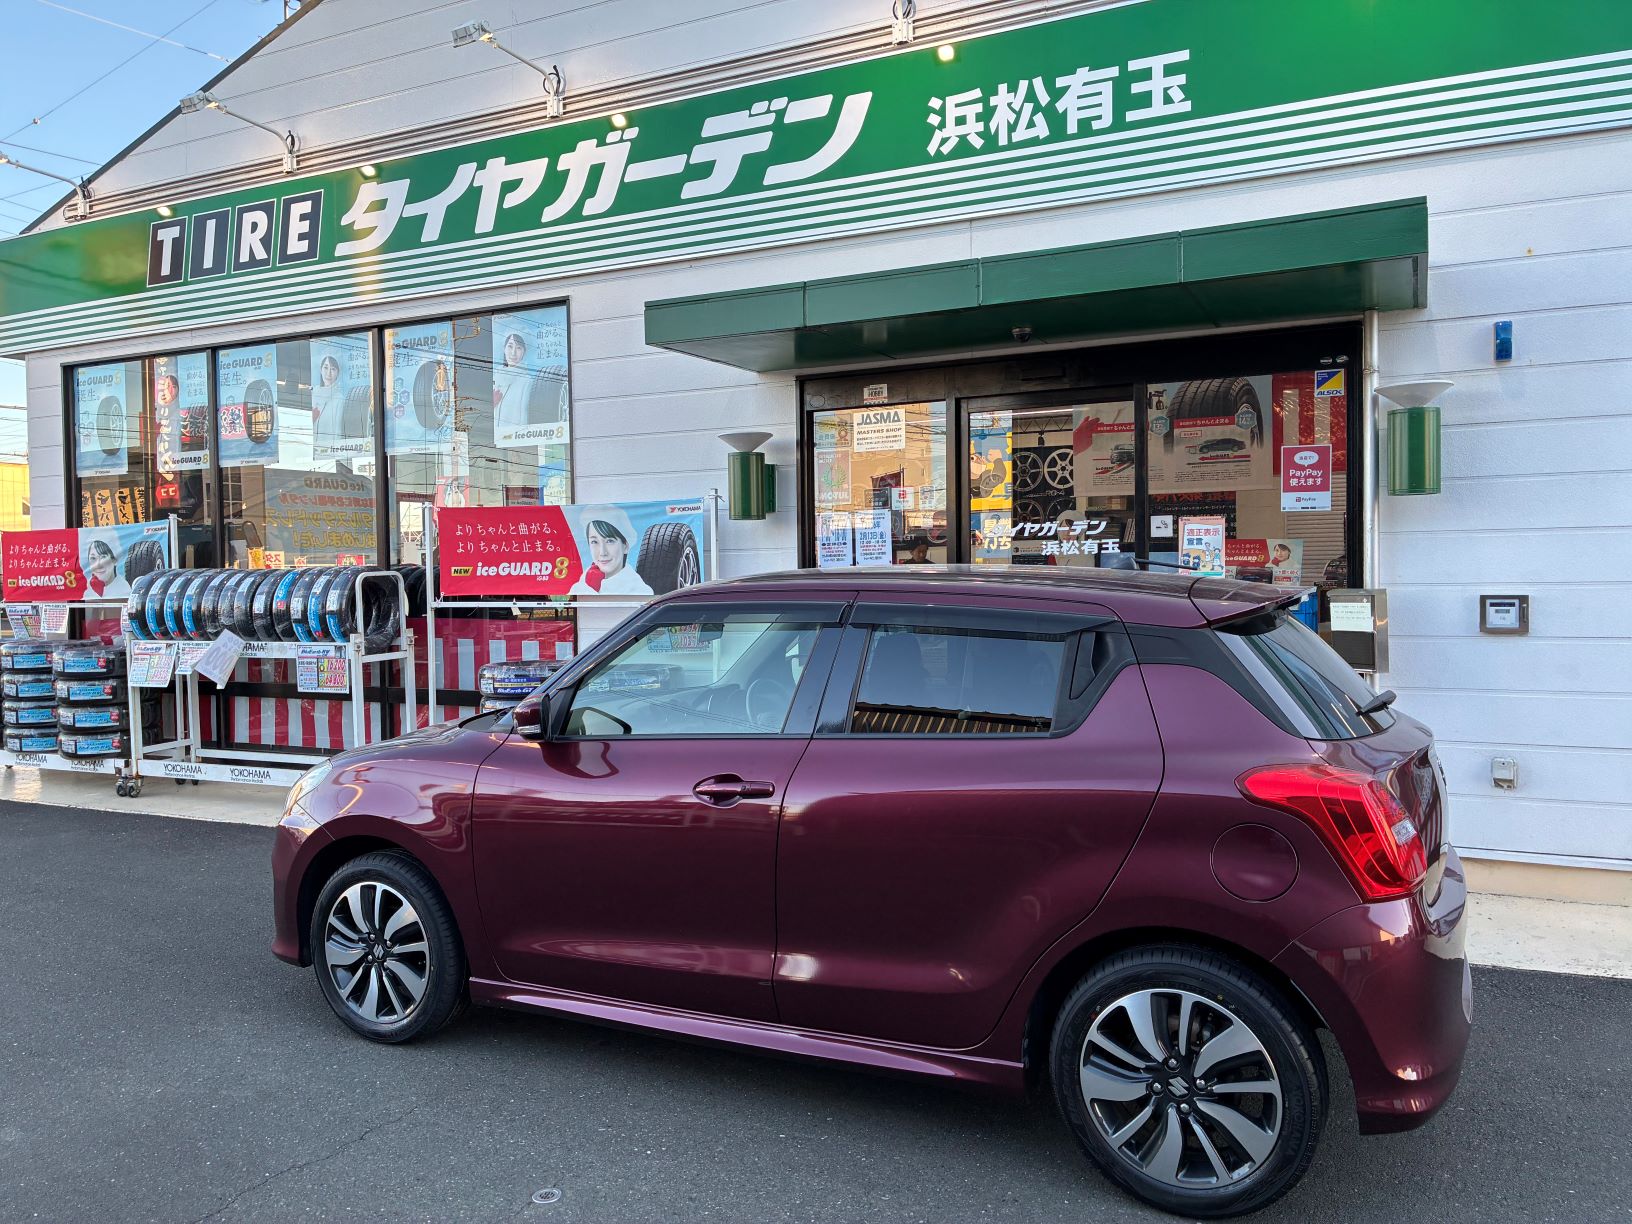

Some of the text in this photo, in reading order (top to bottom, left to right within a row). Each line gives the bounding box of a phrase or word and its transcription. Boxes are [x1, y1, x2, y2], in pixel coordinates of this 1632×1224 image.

[926, 49, 1192, 157] 浜松有玉
[334, 90, 873, 257] タイヤガーデン
[157, 200, 313, 276] TIRE
[857, 411, 901, 426] JASMA
[1289, 468, 1323, 478] PayPay
[1289, 477, 1323, 486] 使えます
[1186, 527, 1220, 536] 適正表示
[1041, 538, 1121, 556] 浜松有玉
[1186, 537, 1203, 546] 宣言
[453, 556, 570, 579] NEW iceGUARD 8
[18, 574, 65, 588] iceGUARD
[163, 763, 203, 775] YOKOHAMA
[229, 768, 271, 780] YOKOHAMA
